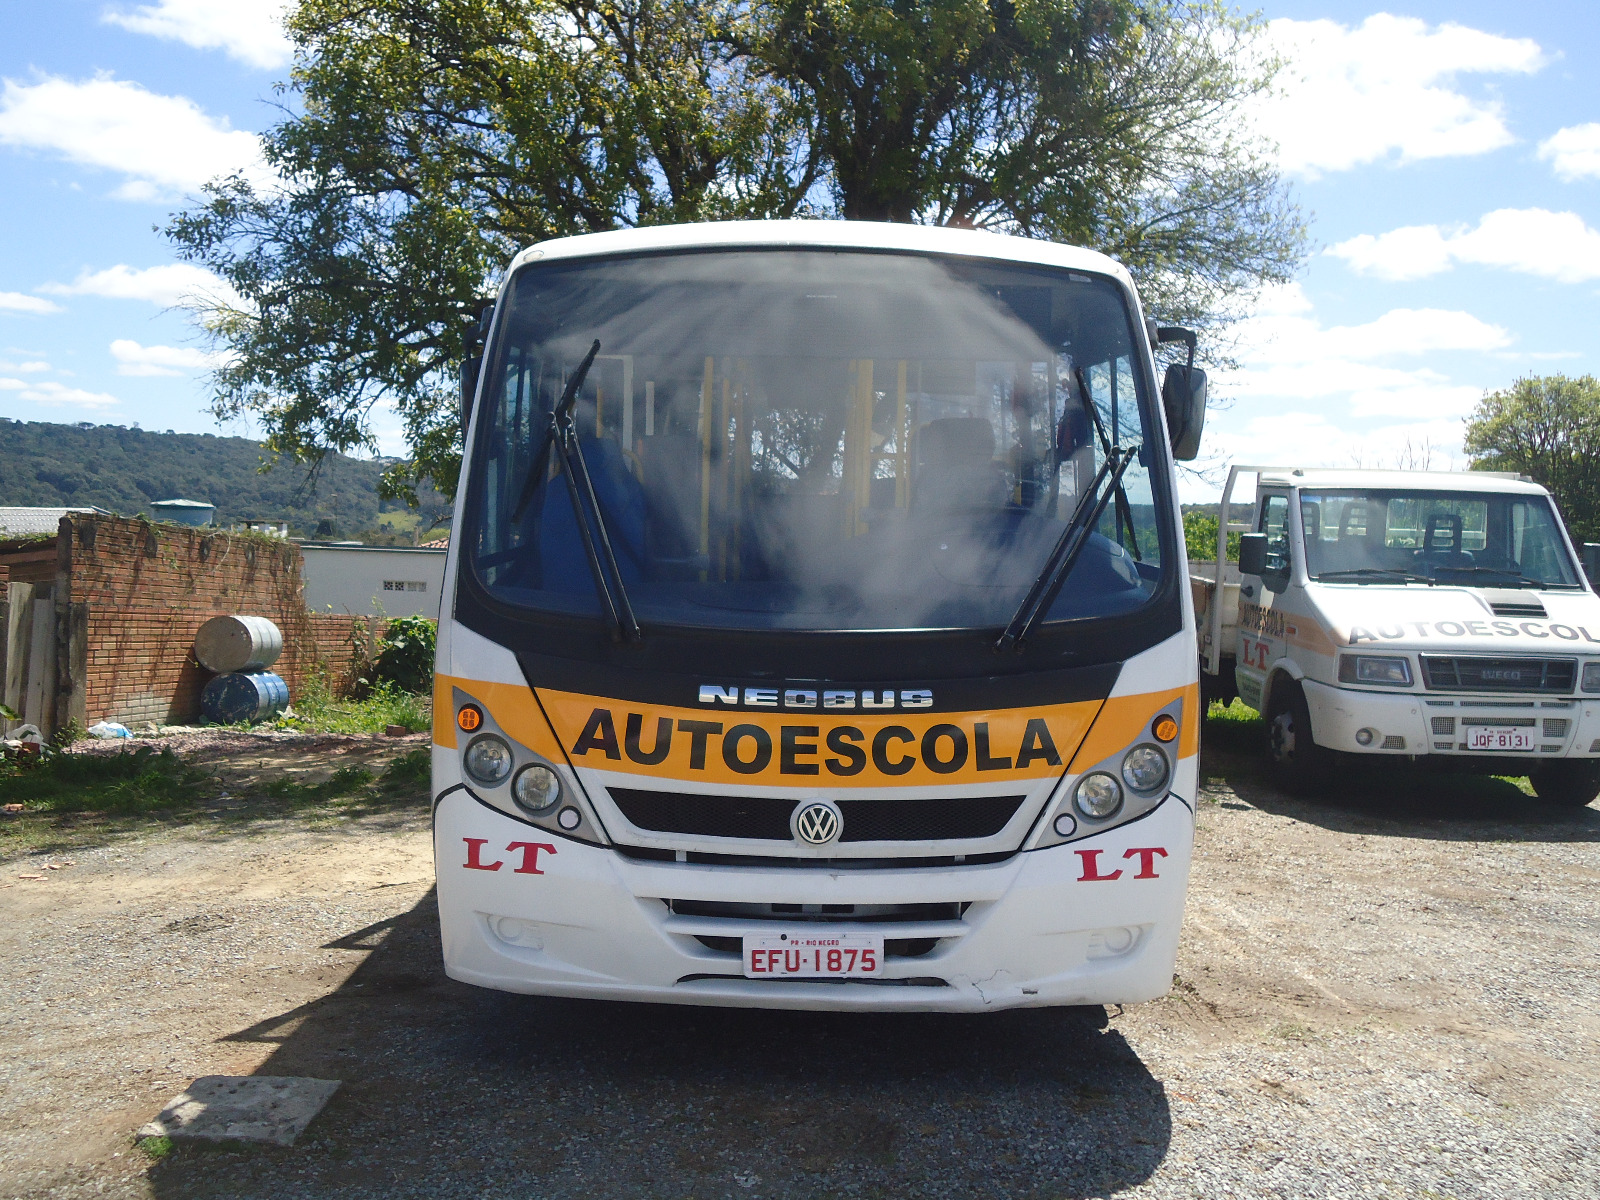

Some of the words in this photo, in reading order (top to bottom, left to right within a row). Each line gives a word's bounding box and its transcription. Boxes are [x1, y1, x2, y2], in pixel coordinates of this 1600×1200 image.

[1242, 603, 1285, 638] AUTOESCOLA
[1242, 638, 1270, 671] LT
[1481, 670, 1521, 681] IVECO
[698, 685, 934, 709] NEOBUS
[571, 707, 1063, 777] AUTOESCOLA
[462, 837, 558, 875] LT
[1074, 846, 1169, 882] LT
